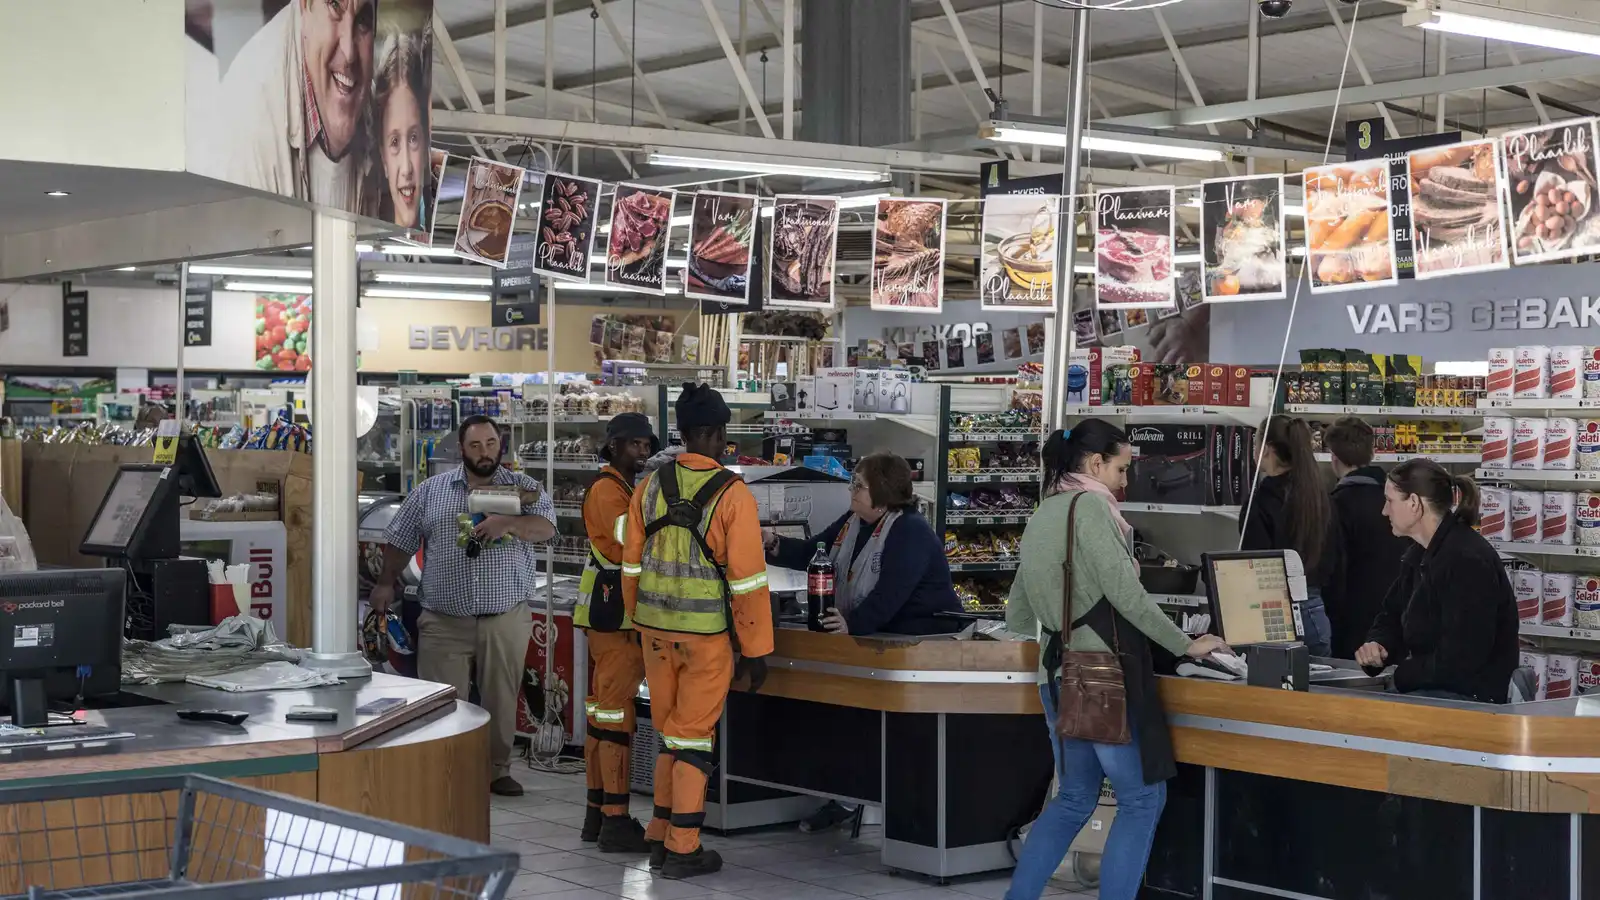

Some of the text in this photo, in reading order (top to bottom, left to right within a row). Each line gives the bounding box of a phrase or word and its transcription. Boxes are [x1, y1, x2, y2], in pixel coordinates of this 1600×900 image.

[1358, 121, 1371, 149] 3
[1509, 127, 1590, 171] Plaaslik
[988, 163, 1000, 188] 4
[704, 196, 735, 225] Vars
[1099, 194, 1171, 226] Plaasvars
[1225, 182, 1257, 216] Vars
[538, 241, 585, 273] Plaaslik
[986, 274, 1050, 304] Plaaslik
[1347, 300, 1452, 334] VARS
[409, 325, 548, 351] BEVRORE
[1128, 428, 1164, 443] Sunbeam
[1177, 431, 1203, 439] GRILL
[250, 549, 273, 598] Bull
[18, 601, 50, 610] packard
[1576, 590, 1599, 601] Selati
[537, 648, 547, 657] OL
